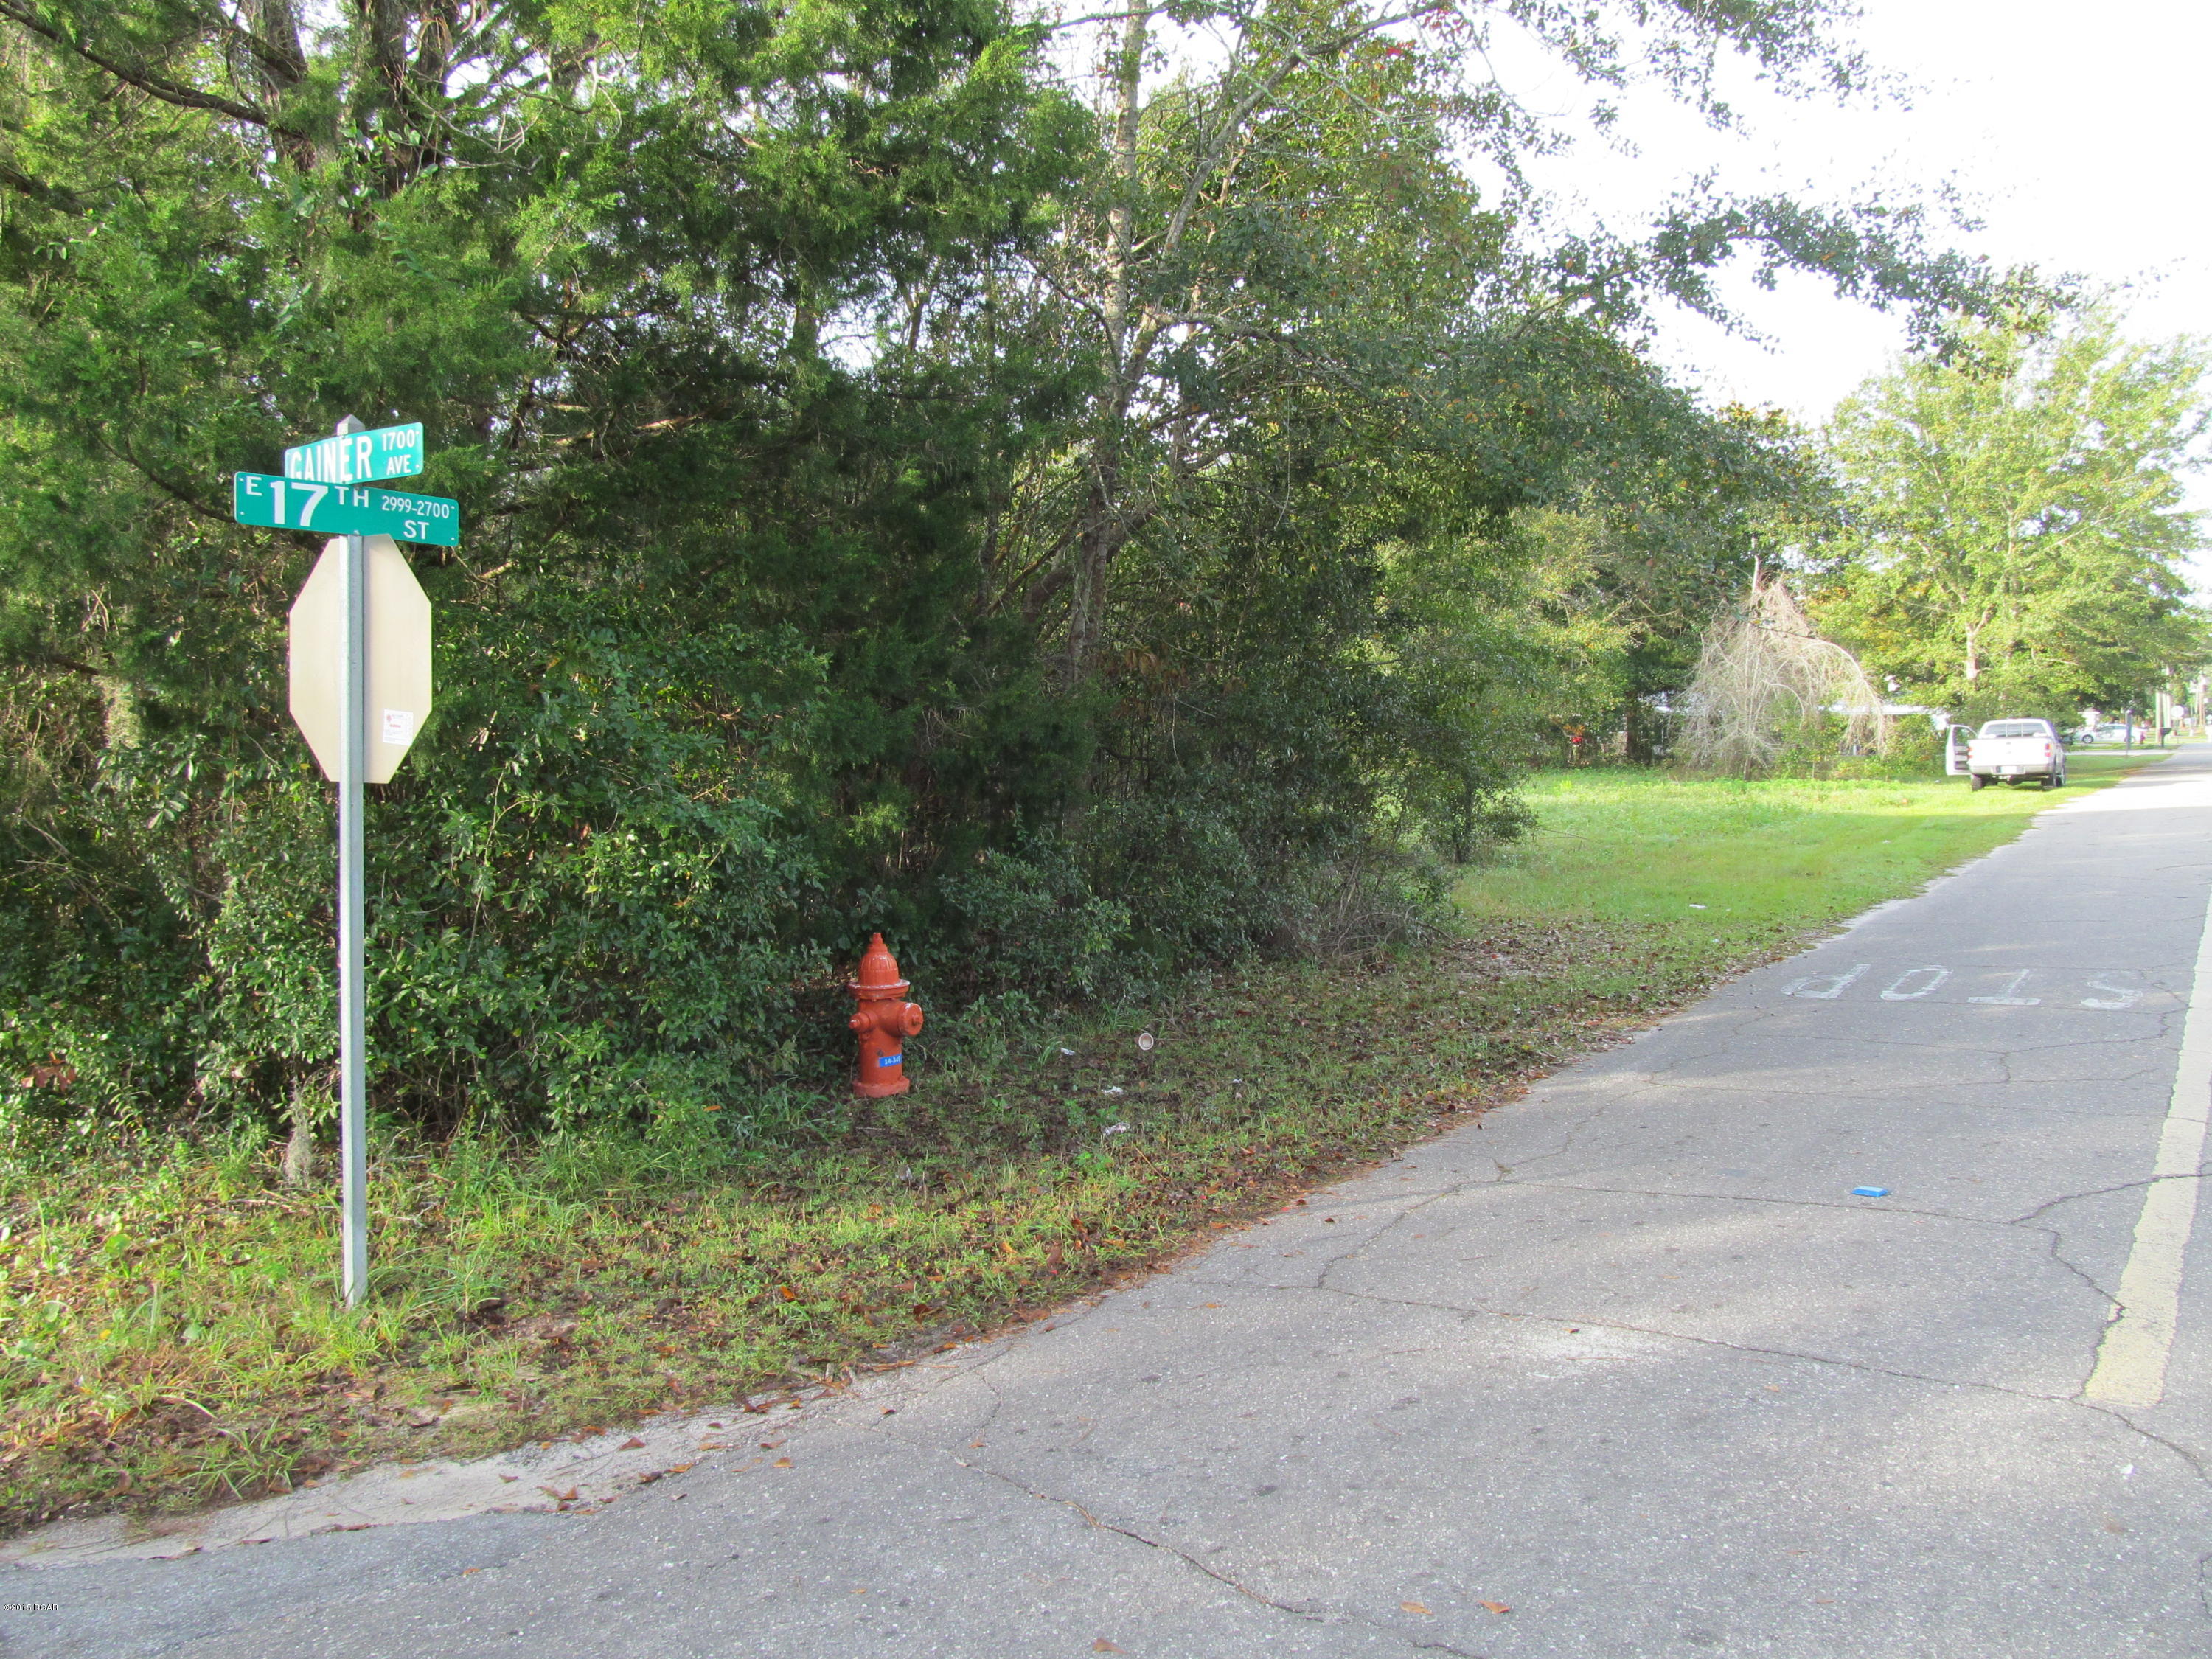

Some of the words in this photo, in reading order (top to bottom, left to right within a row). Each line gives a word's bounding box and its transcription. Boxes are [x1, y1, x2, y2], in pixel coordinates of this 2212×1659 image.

[382, 428, 415, 451] 1700
[290, 435, 372, 483] GAINER
[386, 454, 411, 476] AVE
[246, 476, 262, 496] E
[270, 480, 329, 527] 17
[334, 486, 369, 509] TH
[381, 495, 451, 519] 2999-2700
[403, 520, 430, 540] ST
